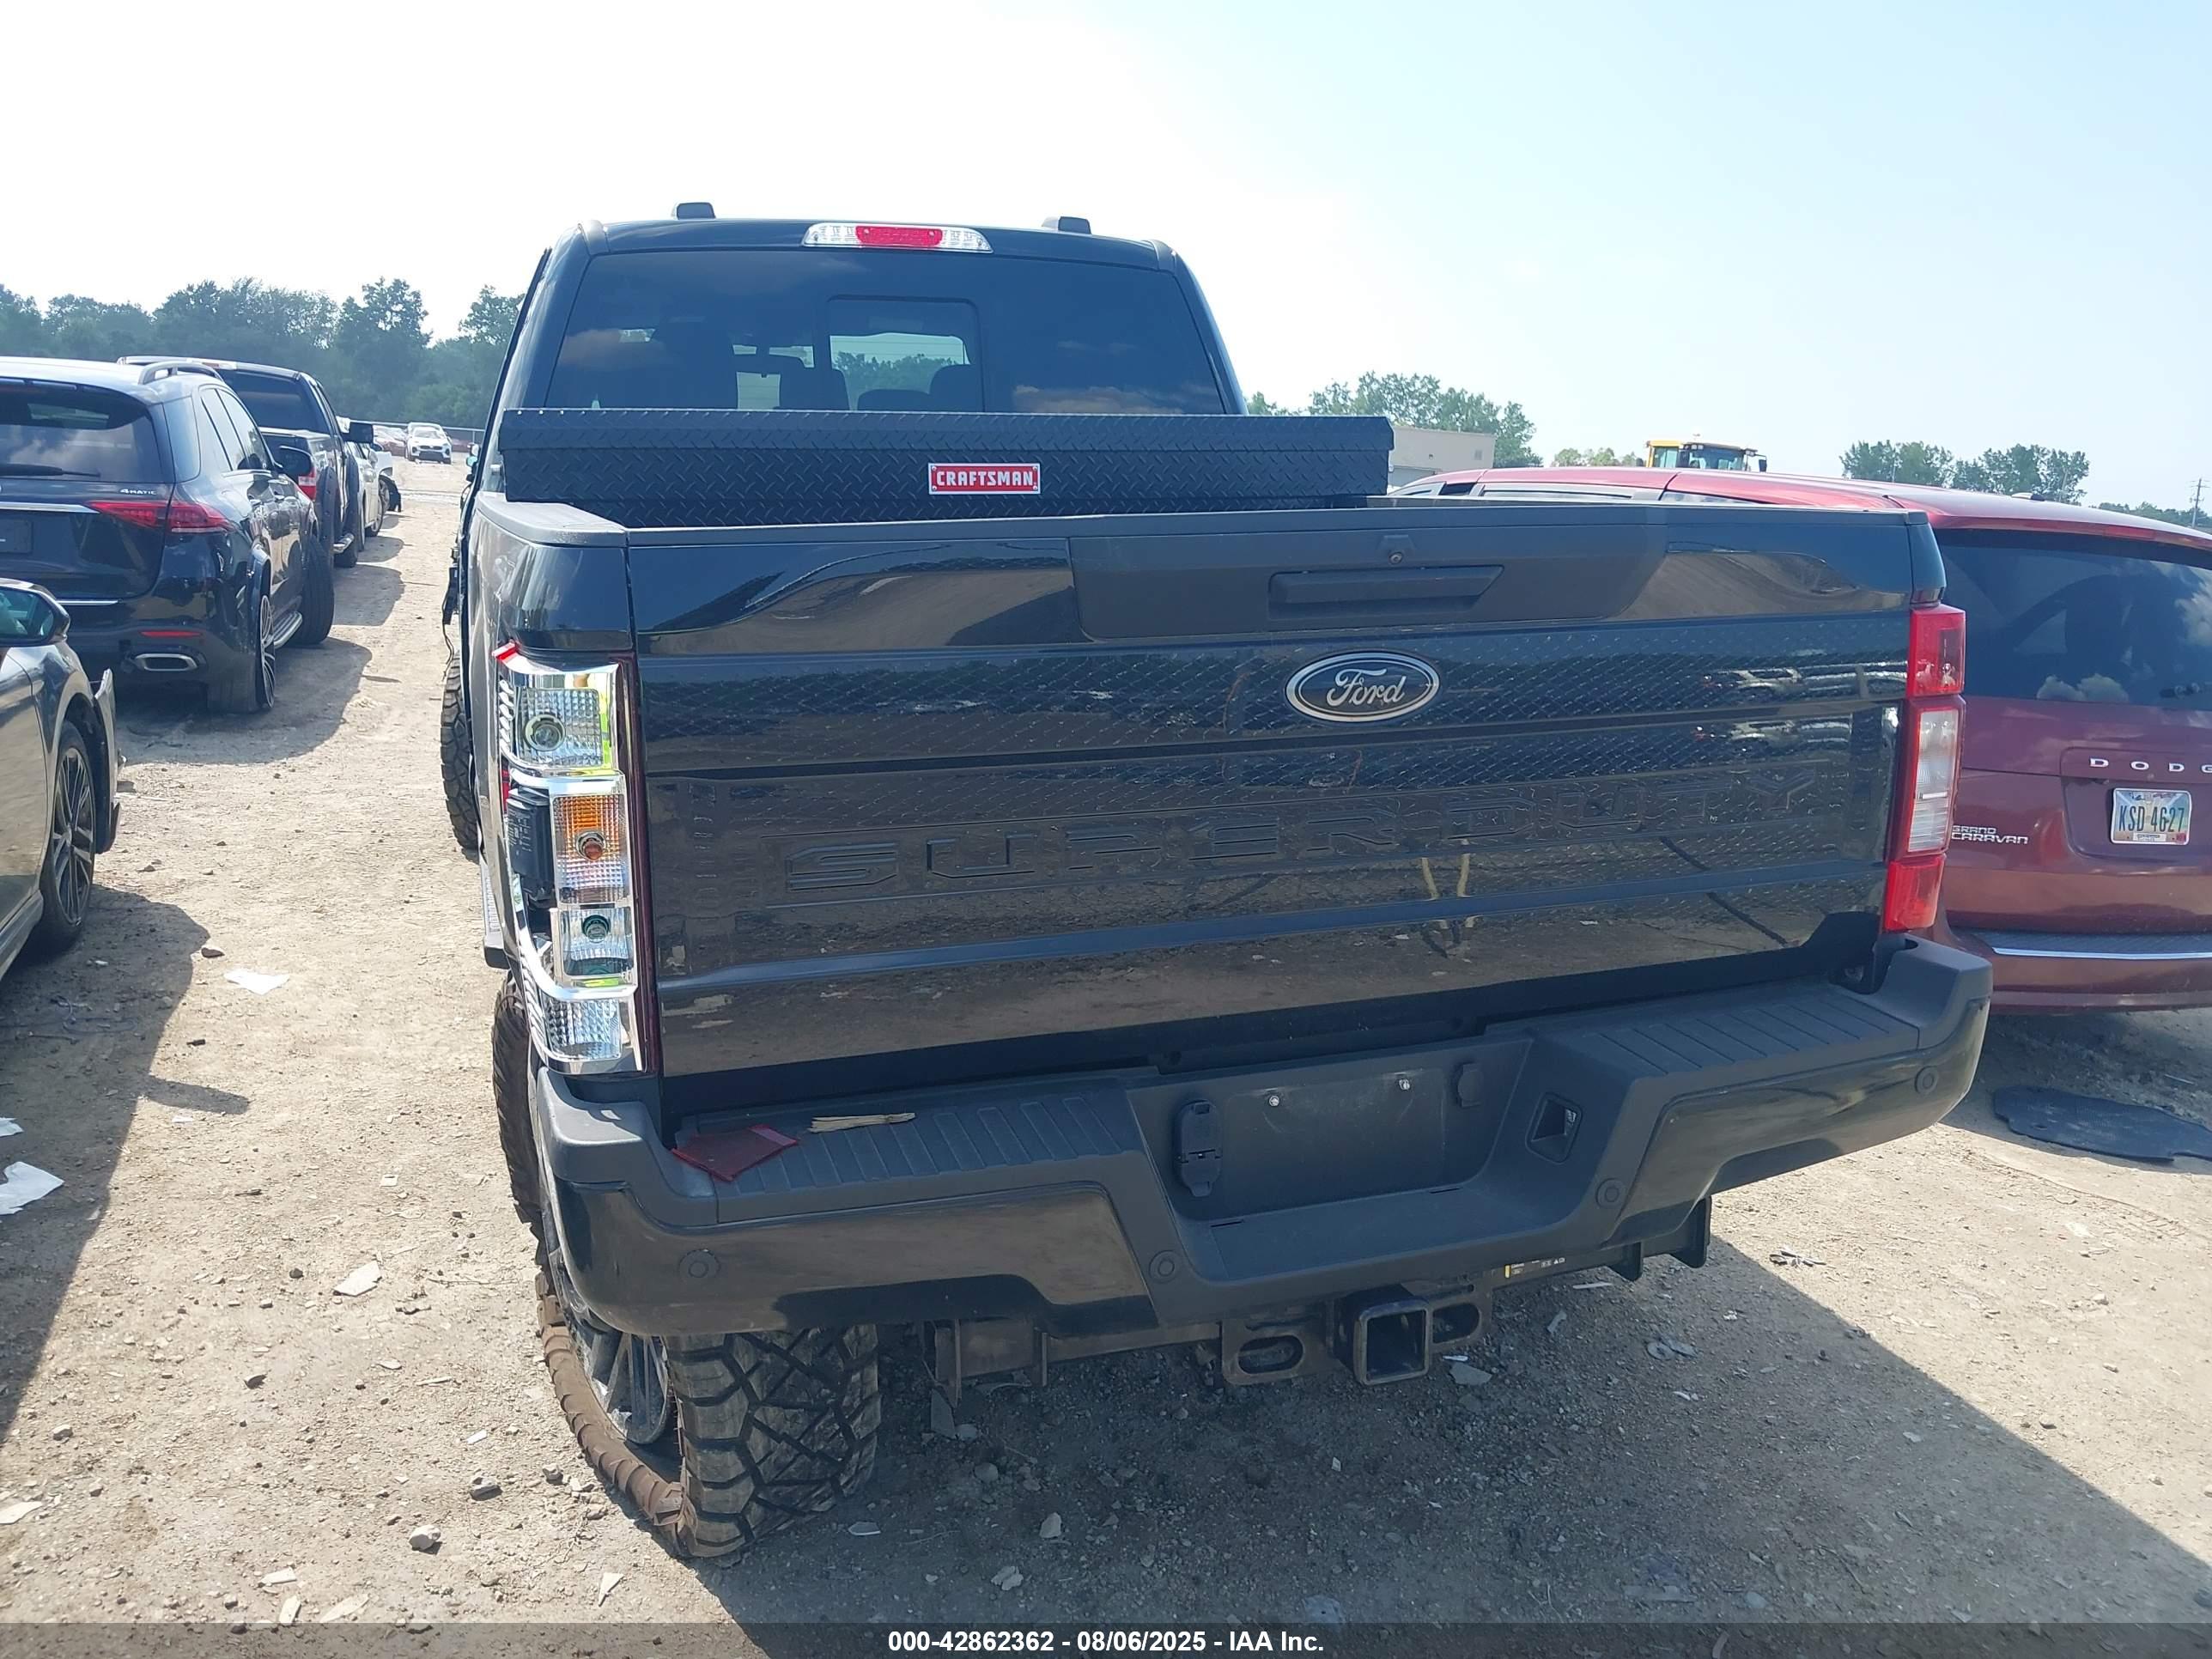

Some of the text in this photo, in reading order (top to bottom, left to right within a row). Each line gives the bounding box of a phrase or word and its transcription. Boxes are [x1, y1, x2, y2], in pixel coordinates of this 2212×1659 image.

[936, 471, 1033, 487] CRAFTSMAN
[1326, 668, 1407, 707] Ford
[1952, 825, 1997, 834] GRAND
[2118, 805, 2185, 833] KSD 4627
[787, 806, 1399, 890] SUPER
[1951, 832, 2029, 845] CARAVAN
